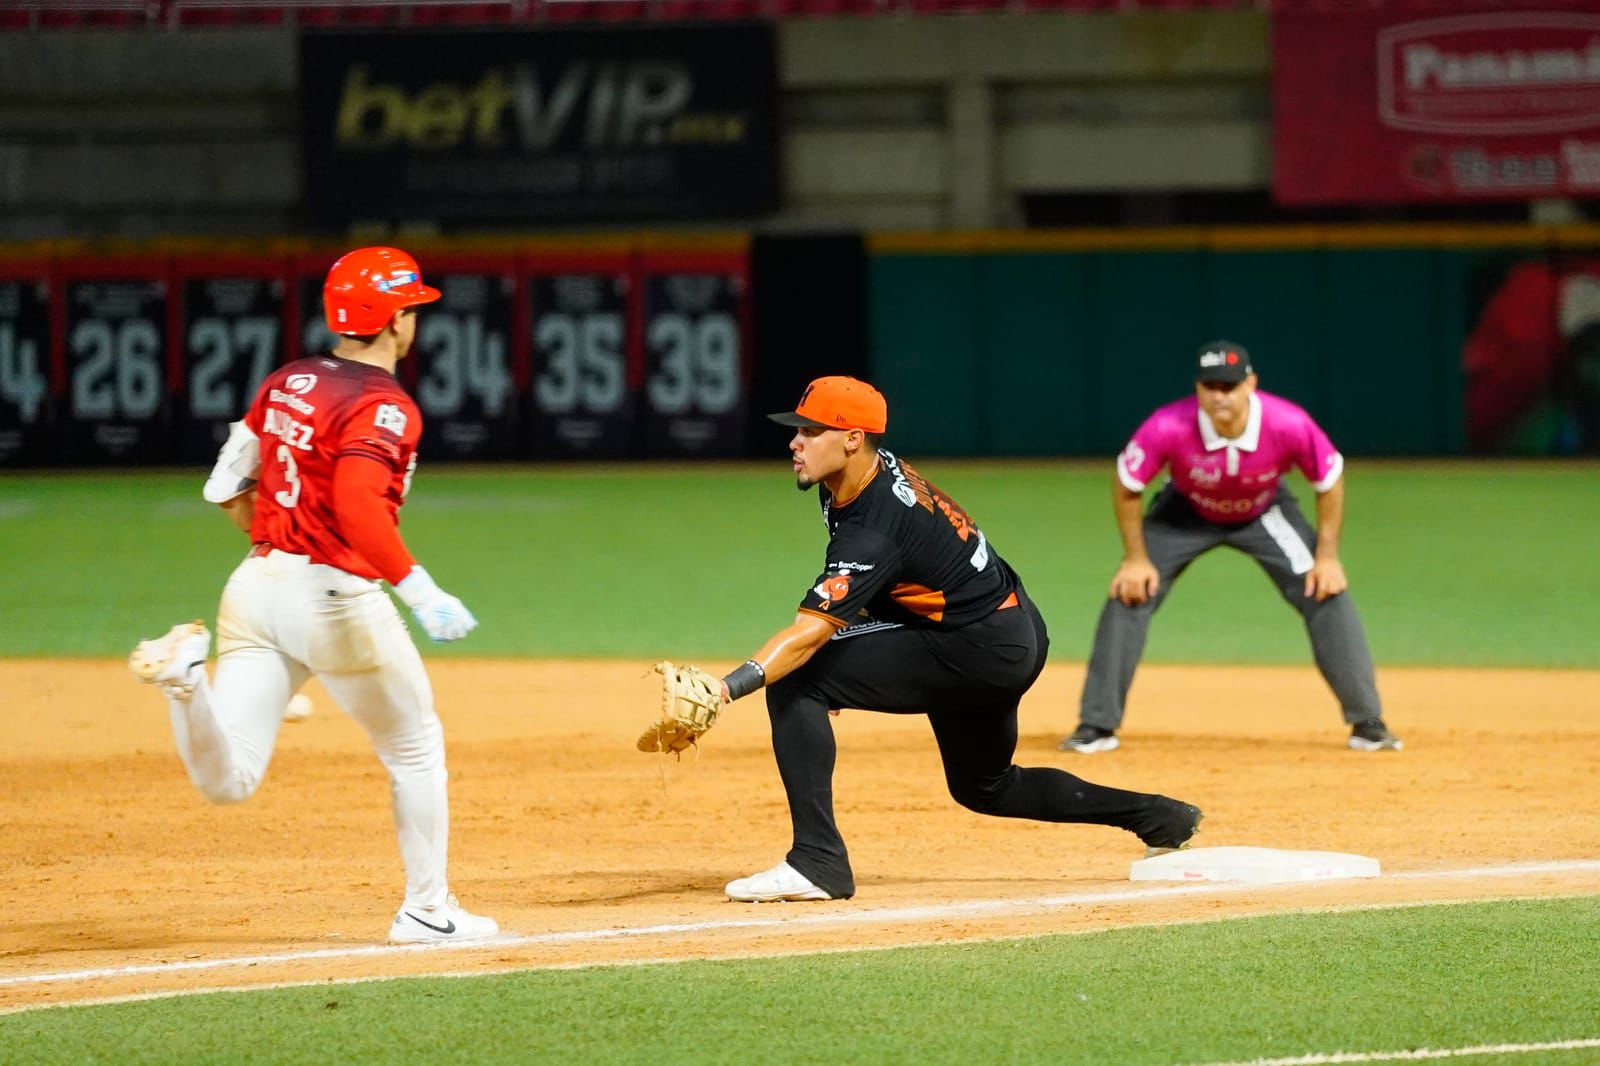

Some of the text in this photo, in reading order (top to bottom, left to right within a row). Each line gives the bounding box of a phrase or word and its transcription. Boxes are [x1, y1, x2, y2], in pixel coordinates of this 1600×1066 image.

[69, 316, 163, 420] 26
[188, 316, 281, 420] 27
[418, 313, 513, 418] 34
[534, 313, 626, 415] 35
[647, 312, 741, 415] 39
[274, 445, 302, 509] 3
